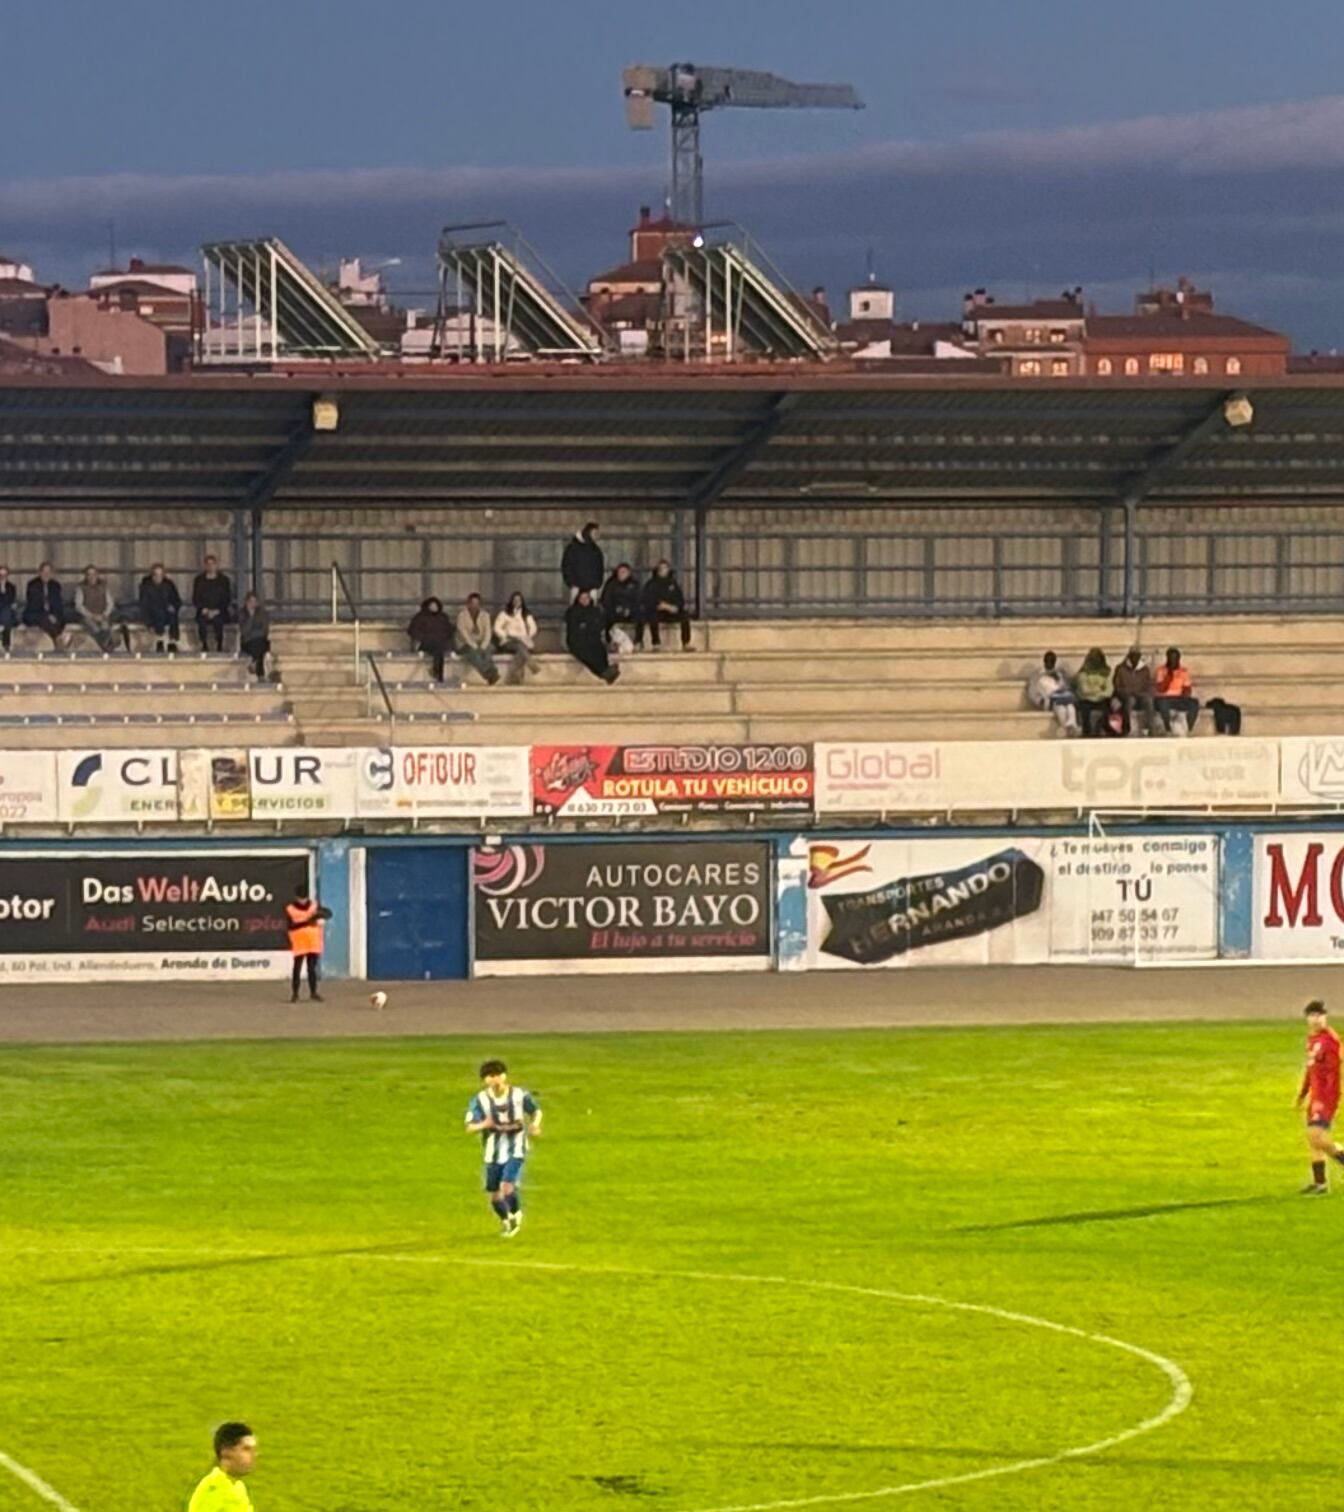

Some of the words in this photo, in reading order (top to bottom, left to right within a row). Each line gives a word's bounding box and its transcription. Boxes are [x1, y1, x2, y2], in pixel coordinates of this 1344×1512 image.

[744, 747, 807, 771] 1200
[827, 748, 940, 779] Global
[603, 779, 678, 797] ROTULA
[683, 779, 708, 796] TU
[713, 774, 809, 795] VEHÍCULO
[1063, 842, 1078, 854] Te
[1142, 839, 1207, 854] conmigo
[586, 863, 760, 888] AUTOCARES
[1059, 862, 1072, 874] el
[1150, 862, 1164, 873] lo
[1167, 862, 1208, 876] pones
[83, 877, 134, 903] Das
[1116, 873, 1152, 902] TÚ
[486, 896, 643, 929] VICTOR
[653, 894, 759, 926] BAYO
[1118, 909, 1136, 922] 50
[1140, 908, 1158, 922] 54
[85, 915, 135, 932] Audi
[142, 915, 240, 933] Selection
[1162, 926, 1179, 939] 77
[591, 931, 608, 949] El
[612, 932, 647, 953] lujo
[654, 935, 664, 948] a
[668, 934, 685, 948] tu
[691, 931, 757, 948] servicio
[161, 958, 208, 970] Aranda
[211, 958, 227, 969] de
[231, 957, 270, 969] Duero
